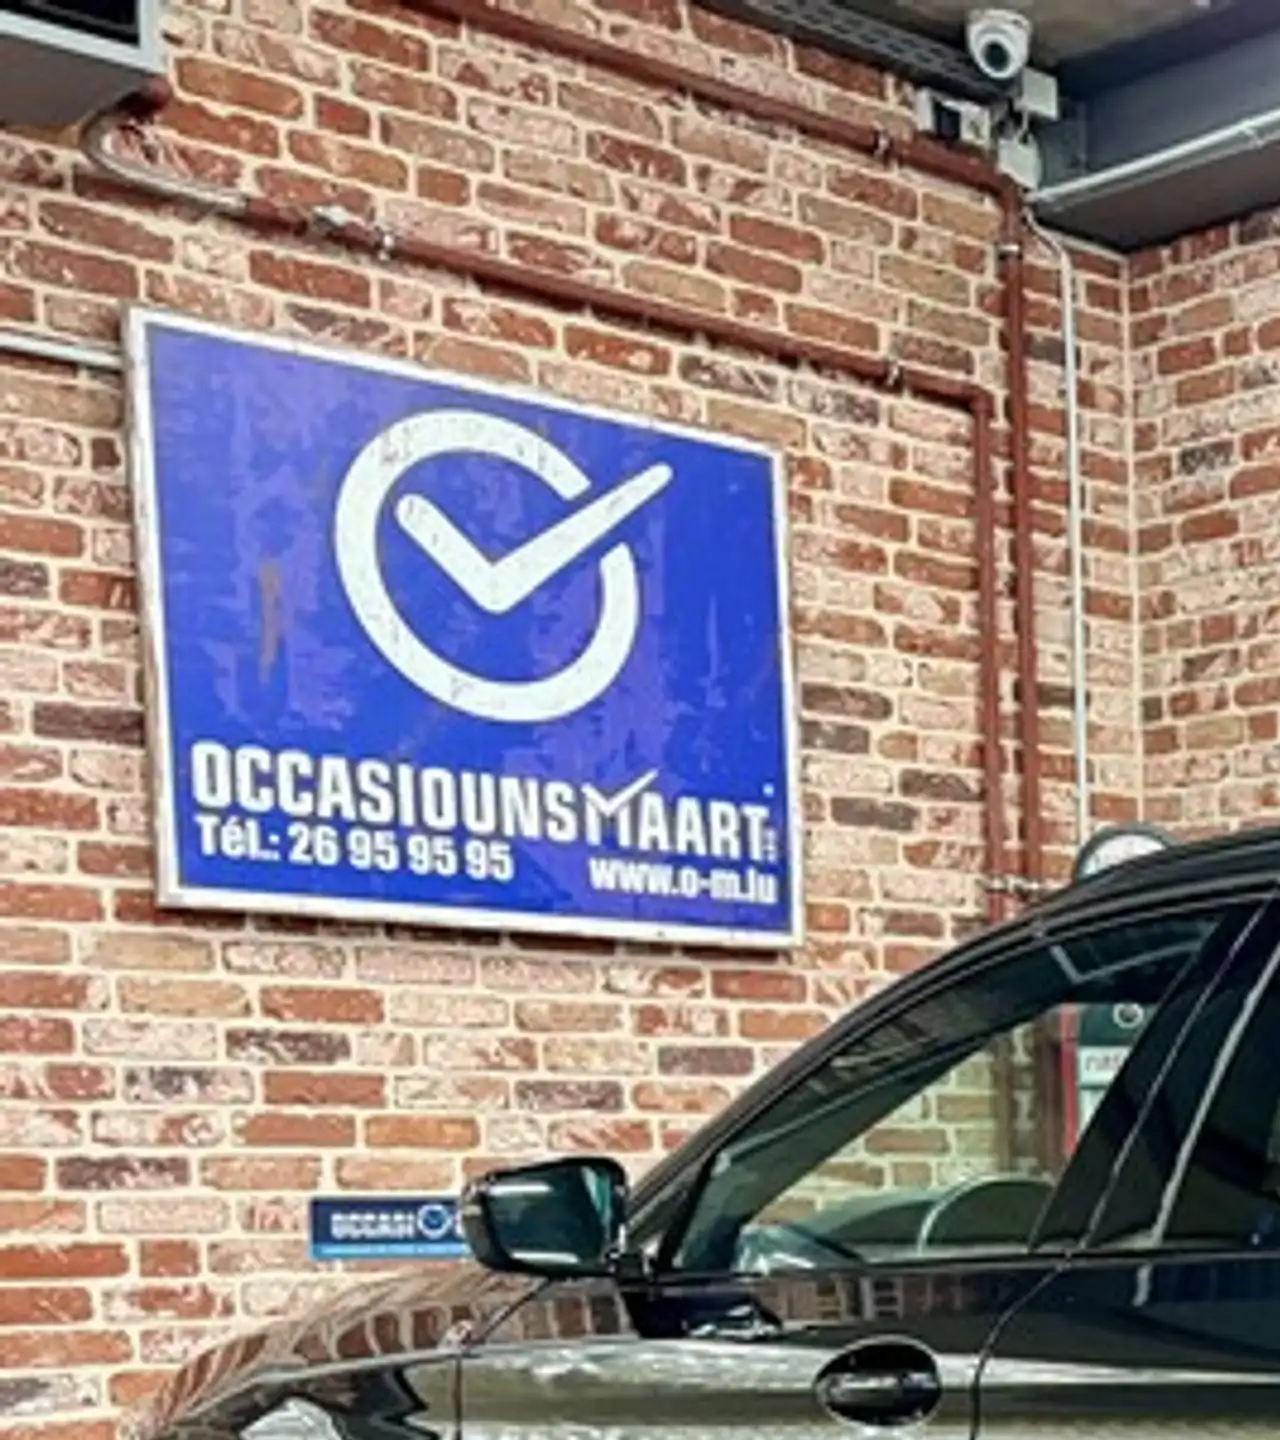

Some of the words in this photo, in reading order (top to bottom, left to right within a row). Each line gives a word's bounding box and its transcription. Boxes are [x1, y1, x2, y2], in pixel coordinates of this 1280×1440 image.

[191, 740, 769, 862] OCCASIOUNSMAART
[287, 821, 341, 867] 26
[347, 826, 400, 872] 95
[407, 833, 459, 877] 95
[464, 839, 514, 881] 95
